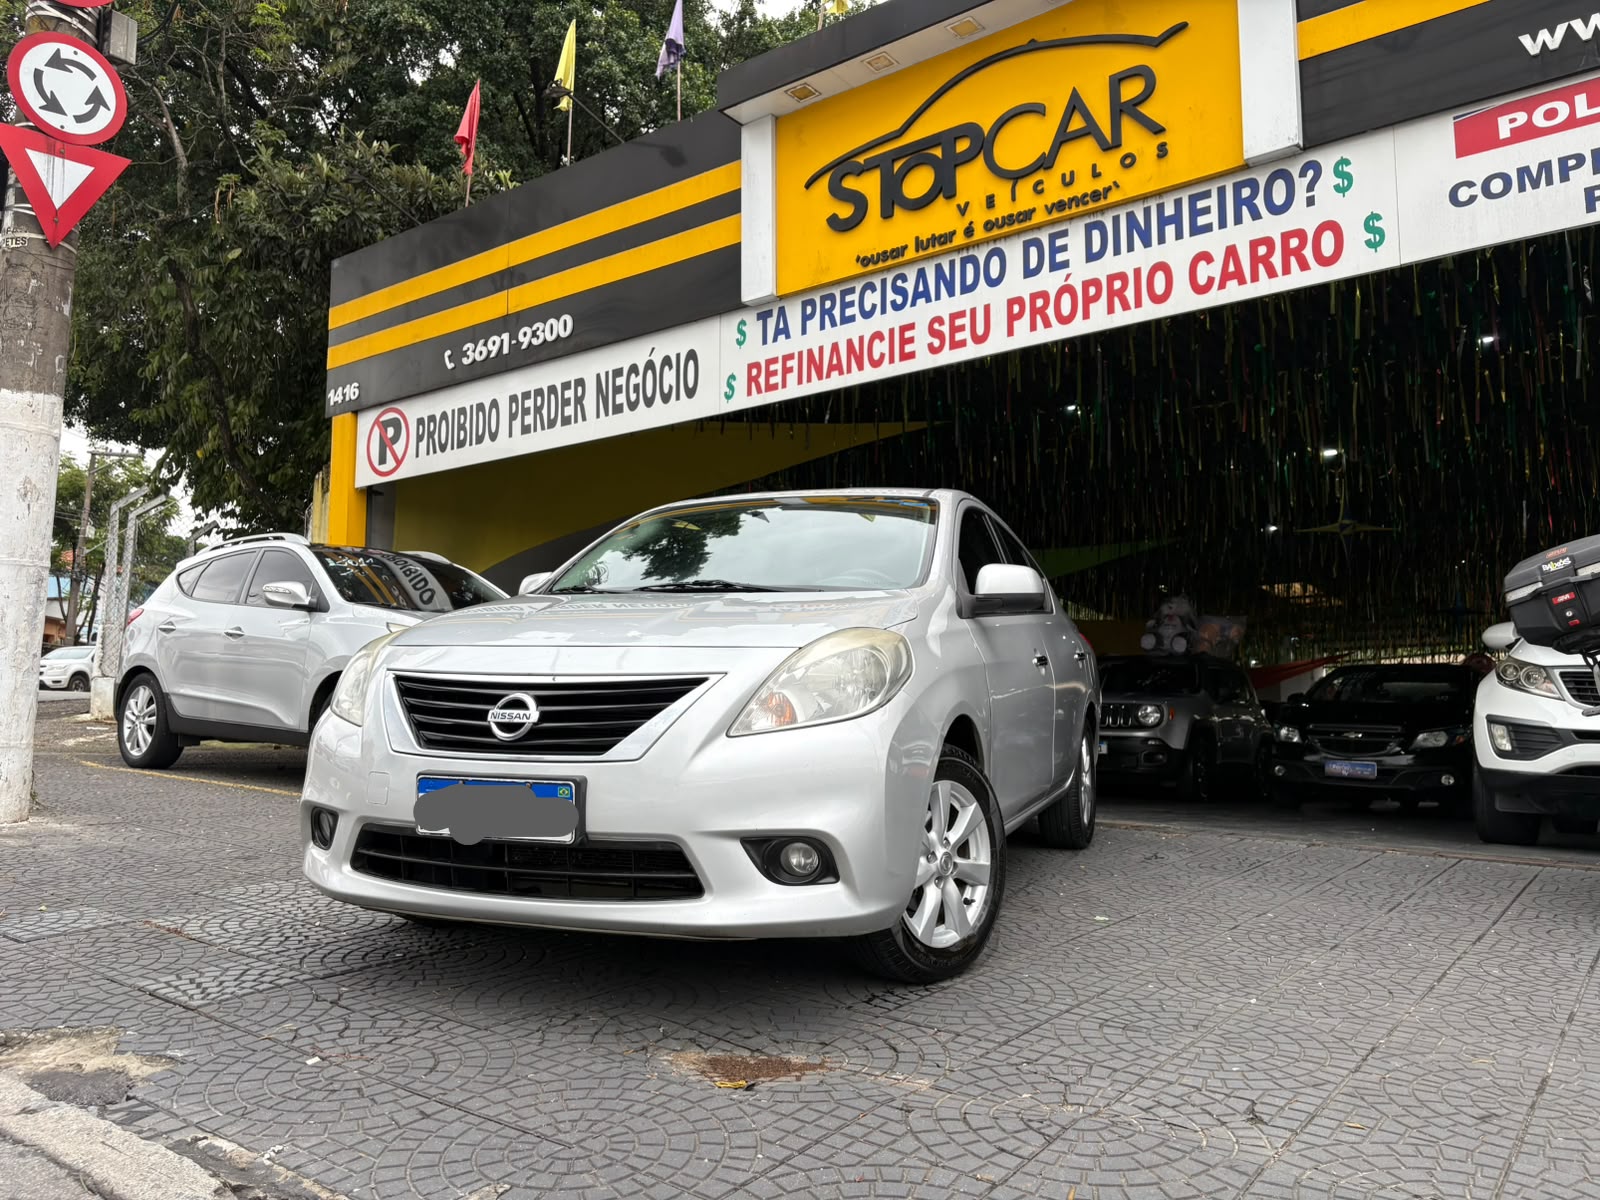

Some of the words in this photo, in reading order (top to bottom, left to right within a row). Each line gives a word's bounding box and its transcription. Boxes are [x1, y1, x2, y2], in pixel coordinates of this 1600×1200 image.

[756, 305, 791, 346] TA
[801, 247, 1007, 337] PRECISANDO
[1022, 228, 1070, 280] DE
[1085, 159, 1323, 264] DINHEIRO?
[914, 227, 956, 252] lutar
[963, 220, 975, 238] é
[983, 207, 1036, 232] ousar
[746, 322, 916, 397] REFINANCIE
[927, 303, 991, 355] SEU
[1006, 261, 1174, 338] PRÓPRIO
[1188, 219, 1345, 296] CARRO
[461, 314, 574, 366] 3691-9300
[328, 382, 360, 406] 1416
[415, 398, 500, 459] PROIBIDO
[508, 377, 586, 438] PERDER
[596, 347, 699, 419] NEGÓCIO
[490, 712, 531, 721] NISSAN
